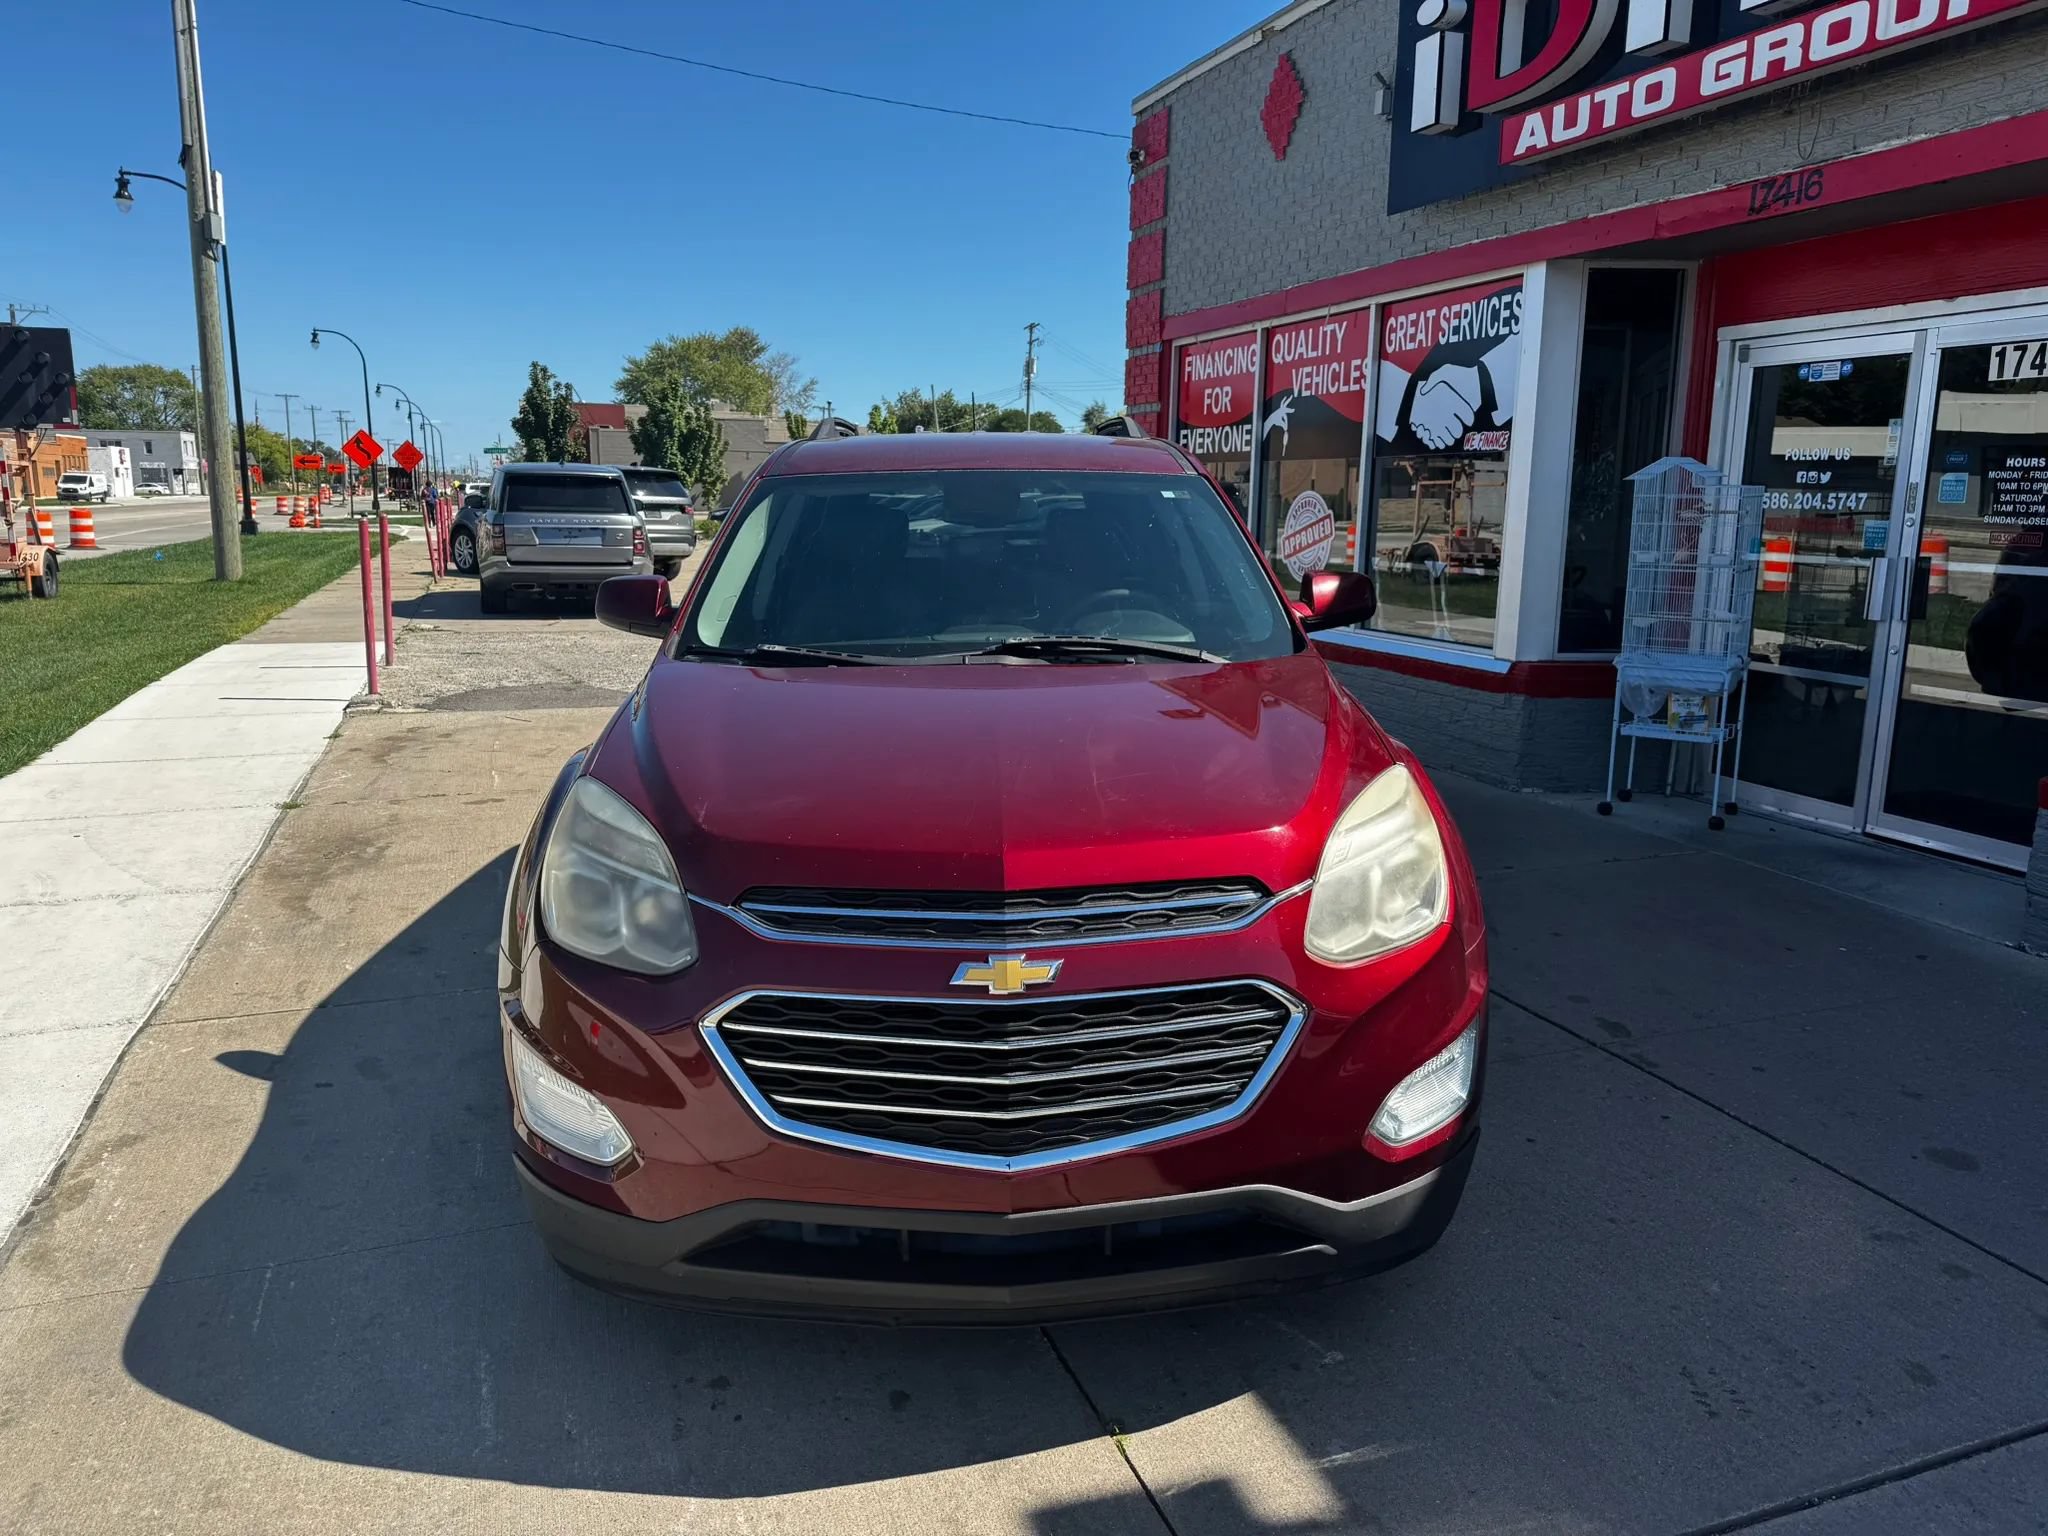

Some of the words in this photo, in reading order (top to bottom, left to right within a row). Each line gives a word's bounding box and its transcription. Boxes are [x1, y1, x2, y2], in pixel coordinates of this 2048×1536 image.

[1513, 67, 1676, 156] AUTO
[1700, 0, 1969, 96] GROU
[1747, 168, 1825, 216] 17416
[1385, 309, 1436, 353] GREAT
[1438, 292, 1524, 345] SERVICES
[1272, 321, 1348, 365] QUALITY
[1184, 344, 1258, 383] FINANCING
[1292, 358, 1369, 398] VEHICLES
[1203, 386, 1232, 415] FOR
[1180, 424, 1252, 454] EVERYONE
[1477, 431, 1509, 450] FINANCE
[1784, 448, 1830, 461] FOLLOW
[1835, 447, 1851, 460] US
[2006, 457, 2046, 467] HOURS
[1988, 471, 2023, 479] MONDAY
[1996, 482, 2018, 490] 10AM
[2020, 482, 2031, 490] TO
[1762, 492, 1868, 510] 586.204.5747
[1993, 504, 2013, 512] 11AM
[2016, 504, 2027, 512] TO
[2028, 504, 2046, 513] 3PM
[2000, 493, 2044, 502] SATURDAY
[1983, 515, 2017, 524] SUNDAY
[1283, 518, 1332, 557] APPROVED
